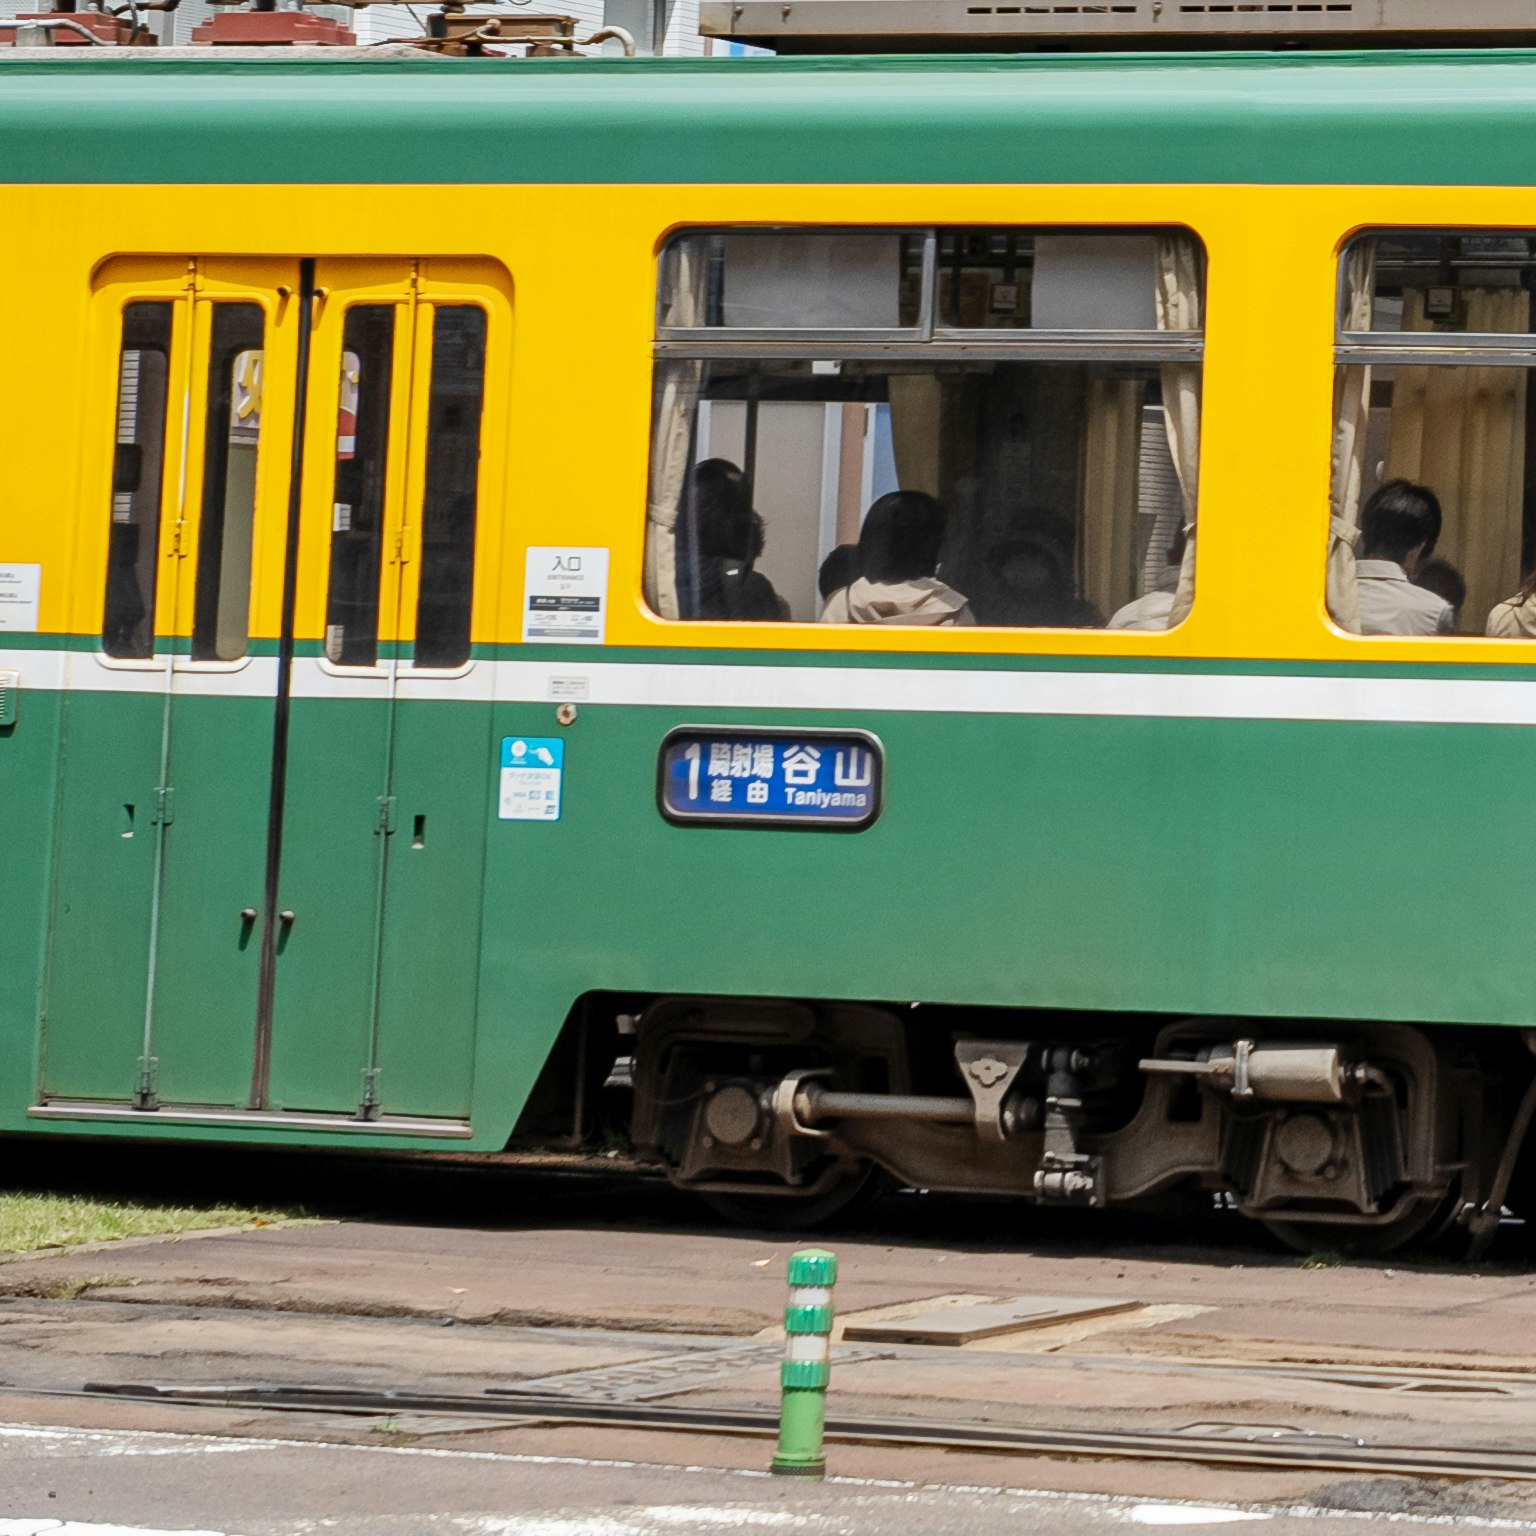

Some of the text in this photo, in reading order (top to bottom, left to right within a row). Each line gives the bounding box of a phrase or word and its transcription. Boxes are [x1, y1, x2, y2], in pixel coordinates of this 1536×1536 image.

[552, 556, 582, 572] 入口
[685, 743, 700, 800] 1
[708, 743, 872, 787] 騎射場 谷山
[710, 779, 769, 804] 経由
[784, 787, 867, 809] Taniyama
